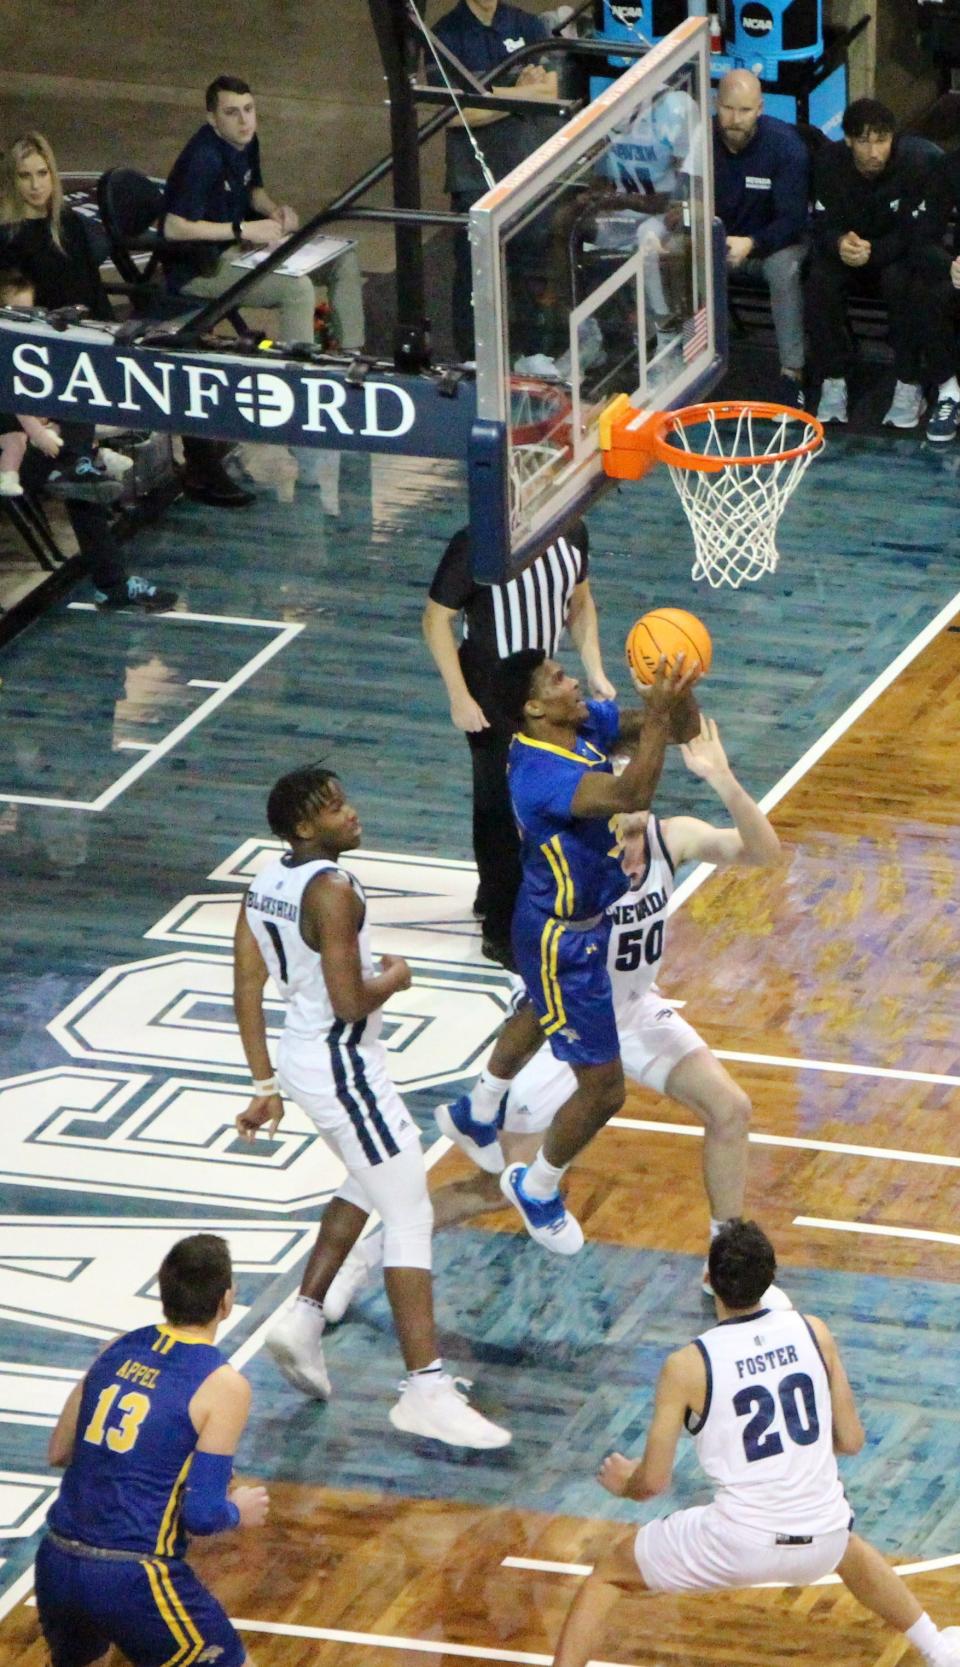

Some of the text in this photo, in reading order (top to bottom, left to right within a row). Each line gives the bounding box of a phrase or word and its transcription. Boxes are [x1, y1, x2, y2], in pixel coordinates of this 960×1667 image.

[742, 16, 773, 31] NCAA
[12, 343, 416, 438] SANFORD
[263, 919, 289, 985] 1
[615, 919, 665, 972] 50
[116, 1359, 161, 1390] APPEL
[735, 1344, 799, 1379] FOSTER
[83, 1383, 151, 1454] 13
[732, 1372, 820, 1463] 20
